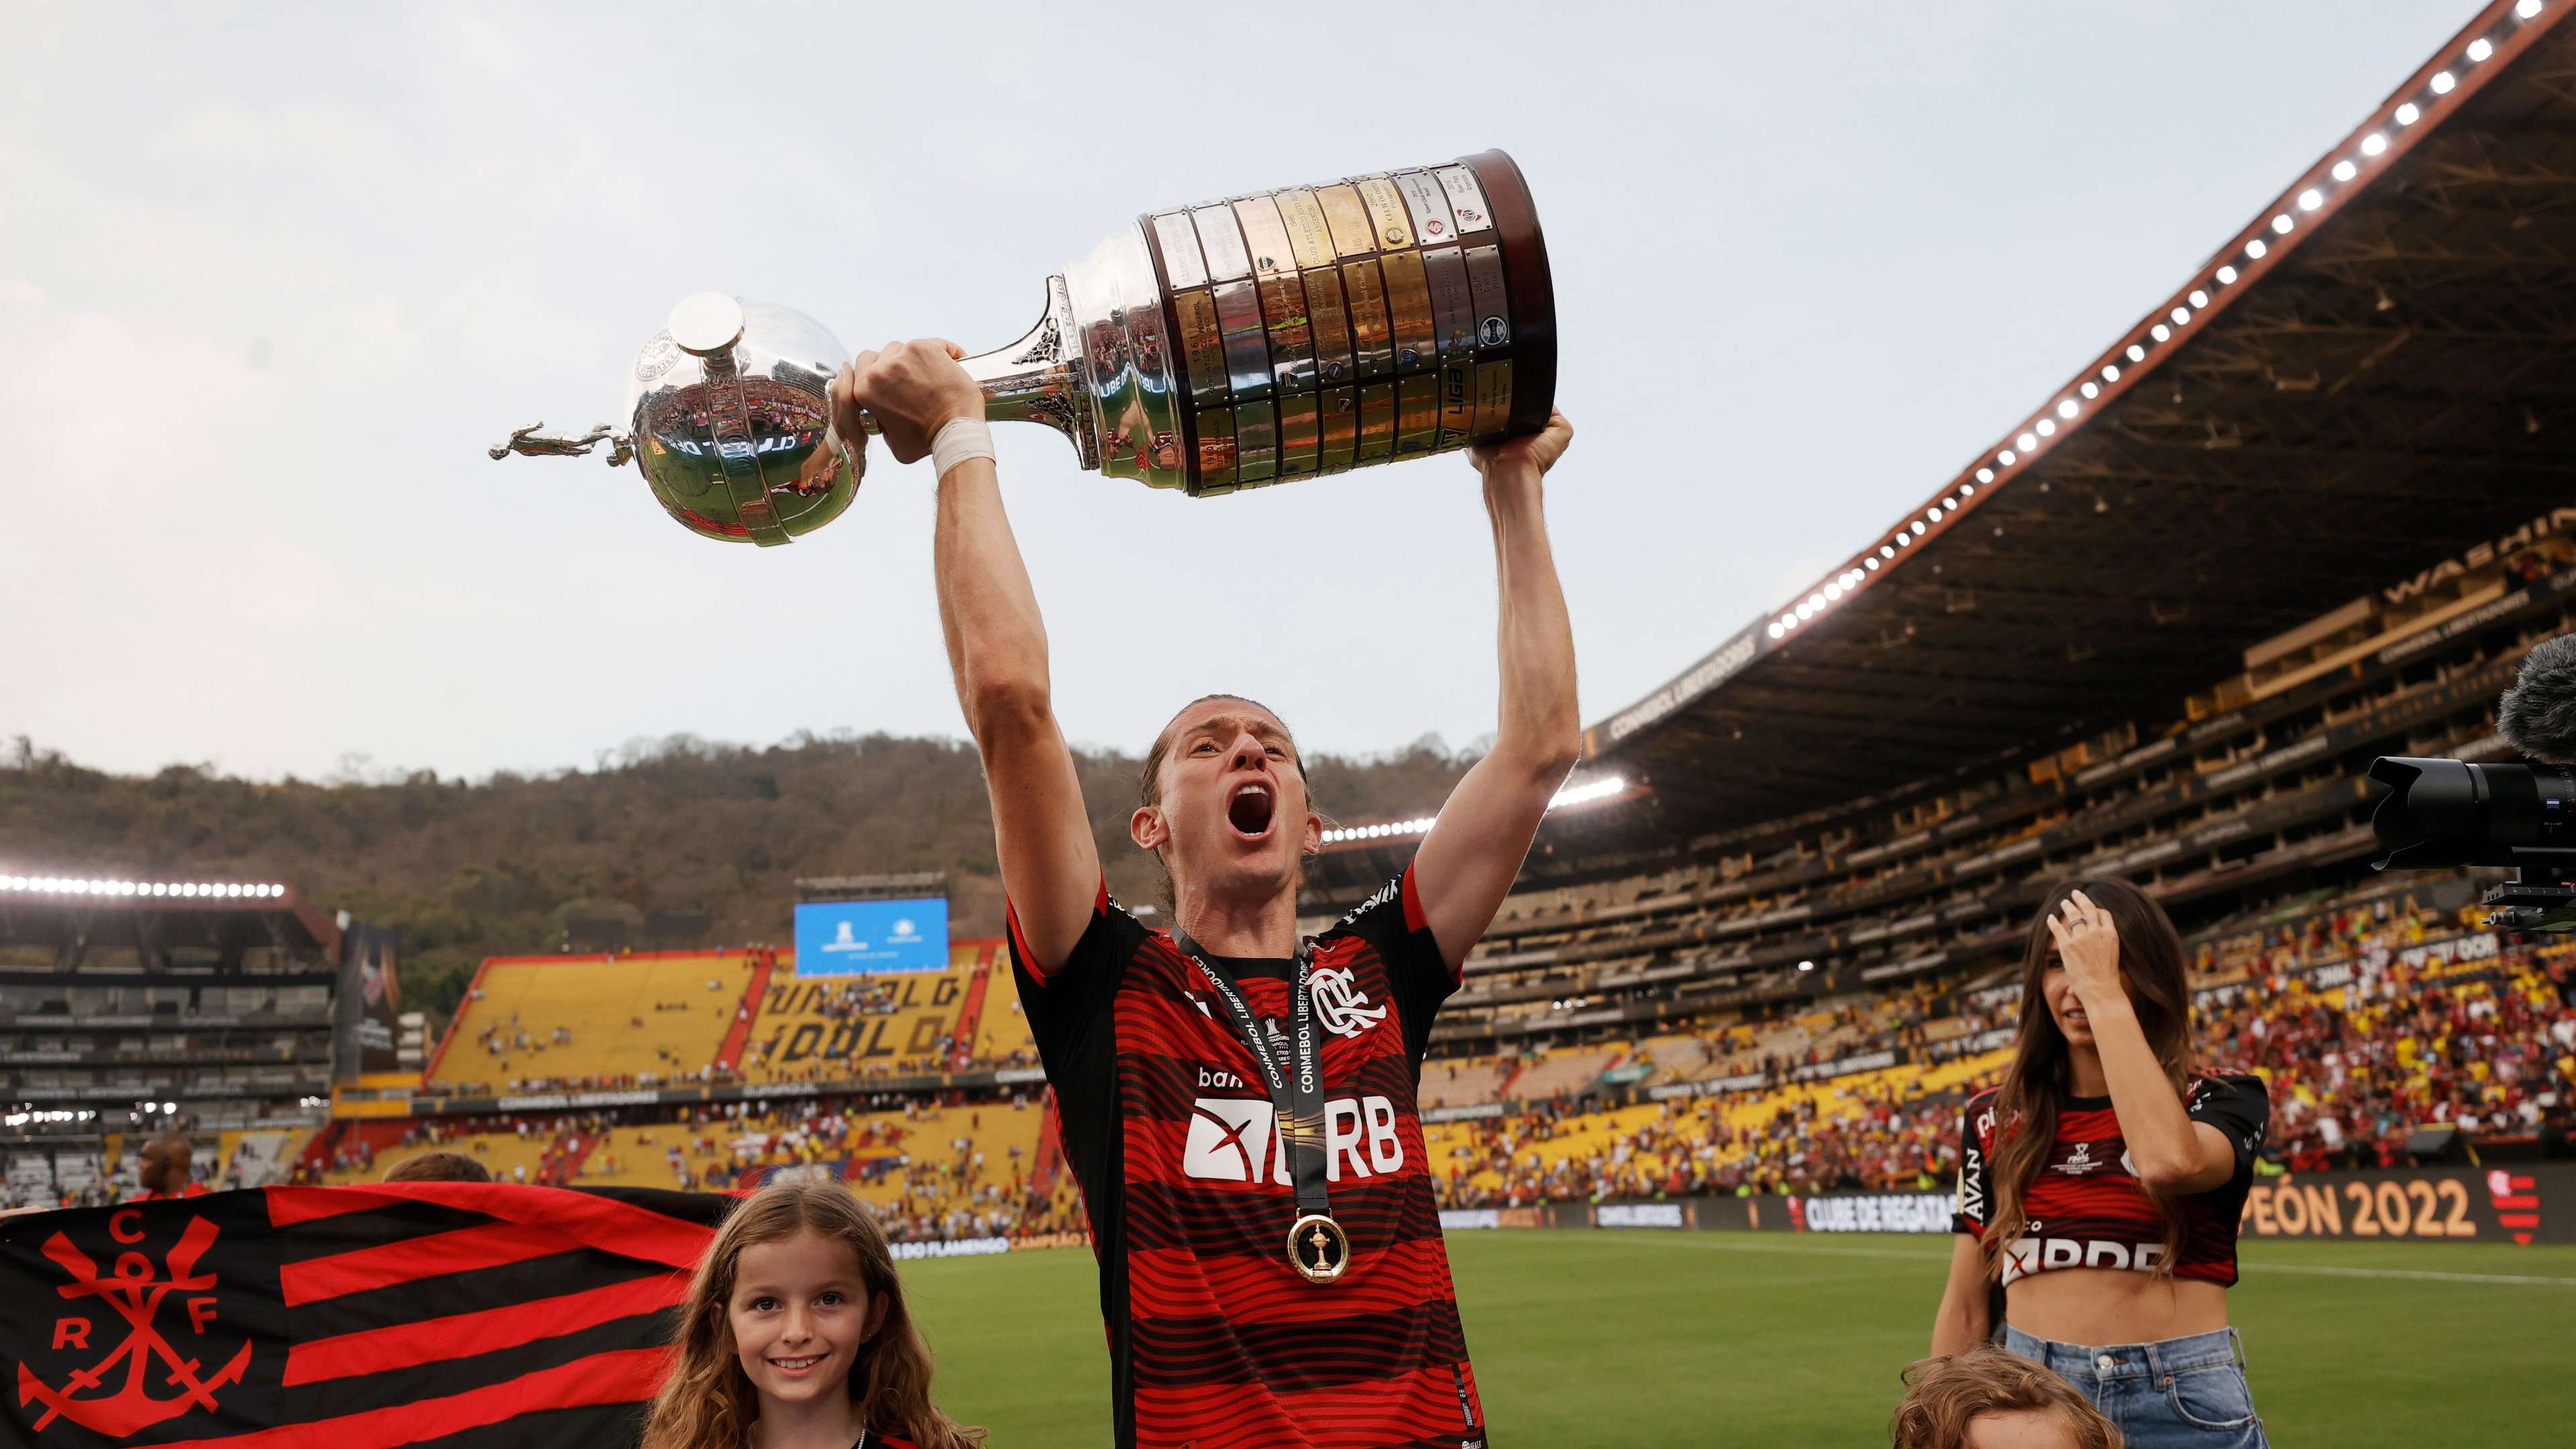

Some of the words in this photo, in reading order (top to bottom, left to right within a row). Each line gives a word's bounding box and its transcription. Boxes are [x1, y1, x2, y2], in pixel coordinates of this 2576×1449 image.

[1381, 203, 1393, 221] CLUB
[1309, 246, 1320, 264] CLUB
[1189, 336, 1201, 364] 1961
[1191, 955, 1250, 1019] LIBERTADORES
[1245, 1022, 1283, 1089] CONMEBOL
[1298, 1023, 1314, 1093] CONMEBOL
[1199, 1067, 1243, 1088] ban
[1964, 1148, 1984, 1226] AVAN
[2345, 1179, 2477, 1236] 2022
[109, 1210, 146, 1244] C
[927, 1237, 1010, 1256] FLAMENGO
[52, 1318, 91, 1350] R
[187, 1297, 218, 1334] F
